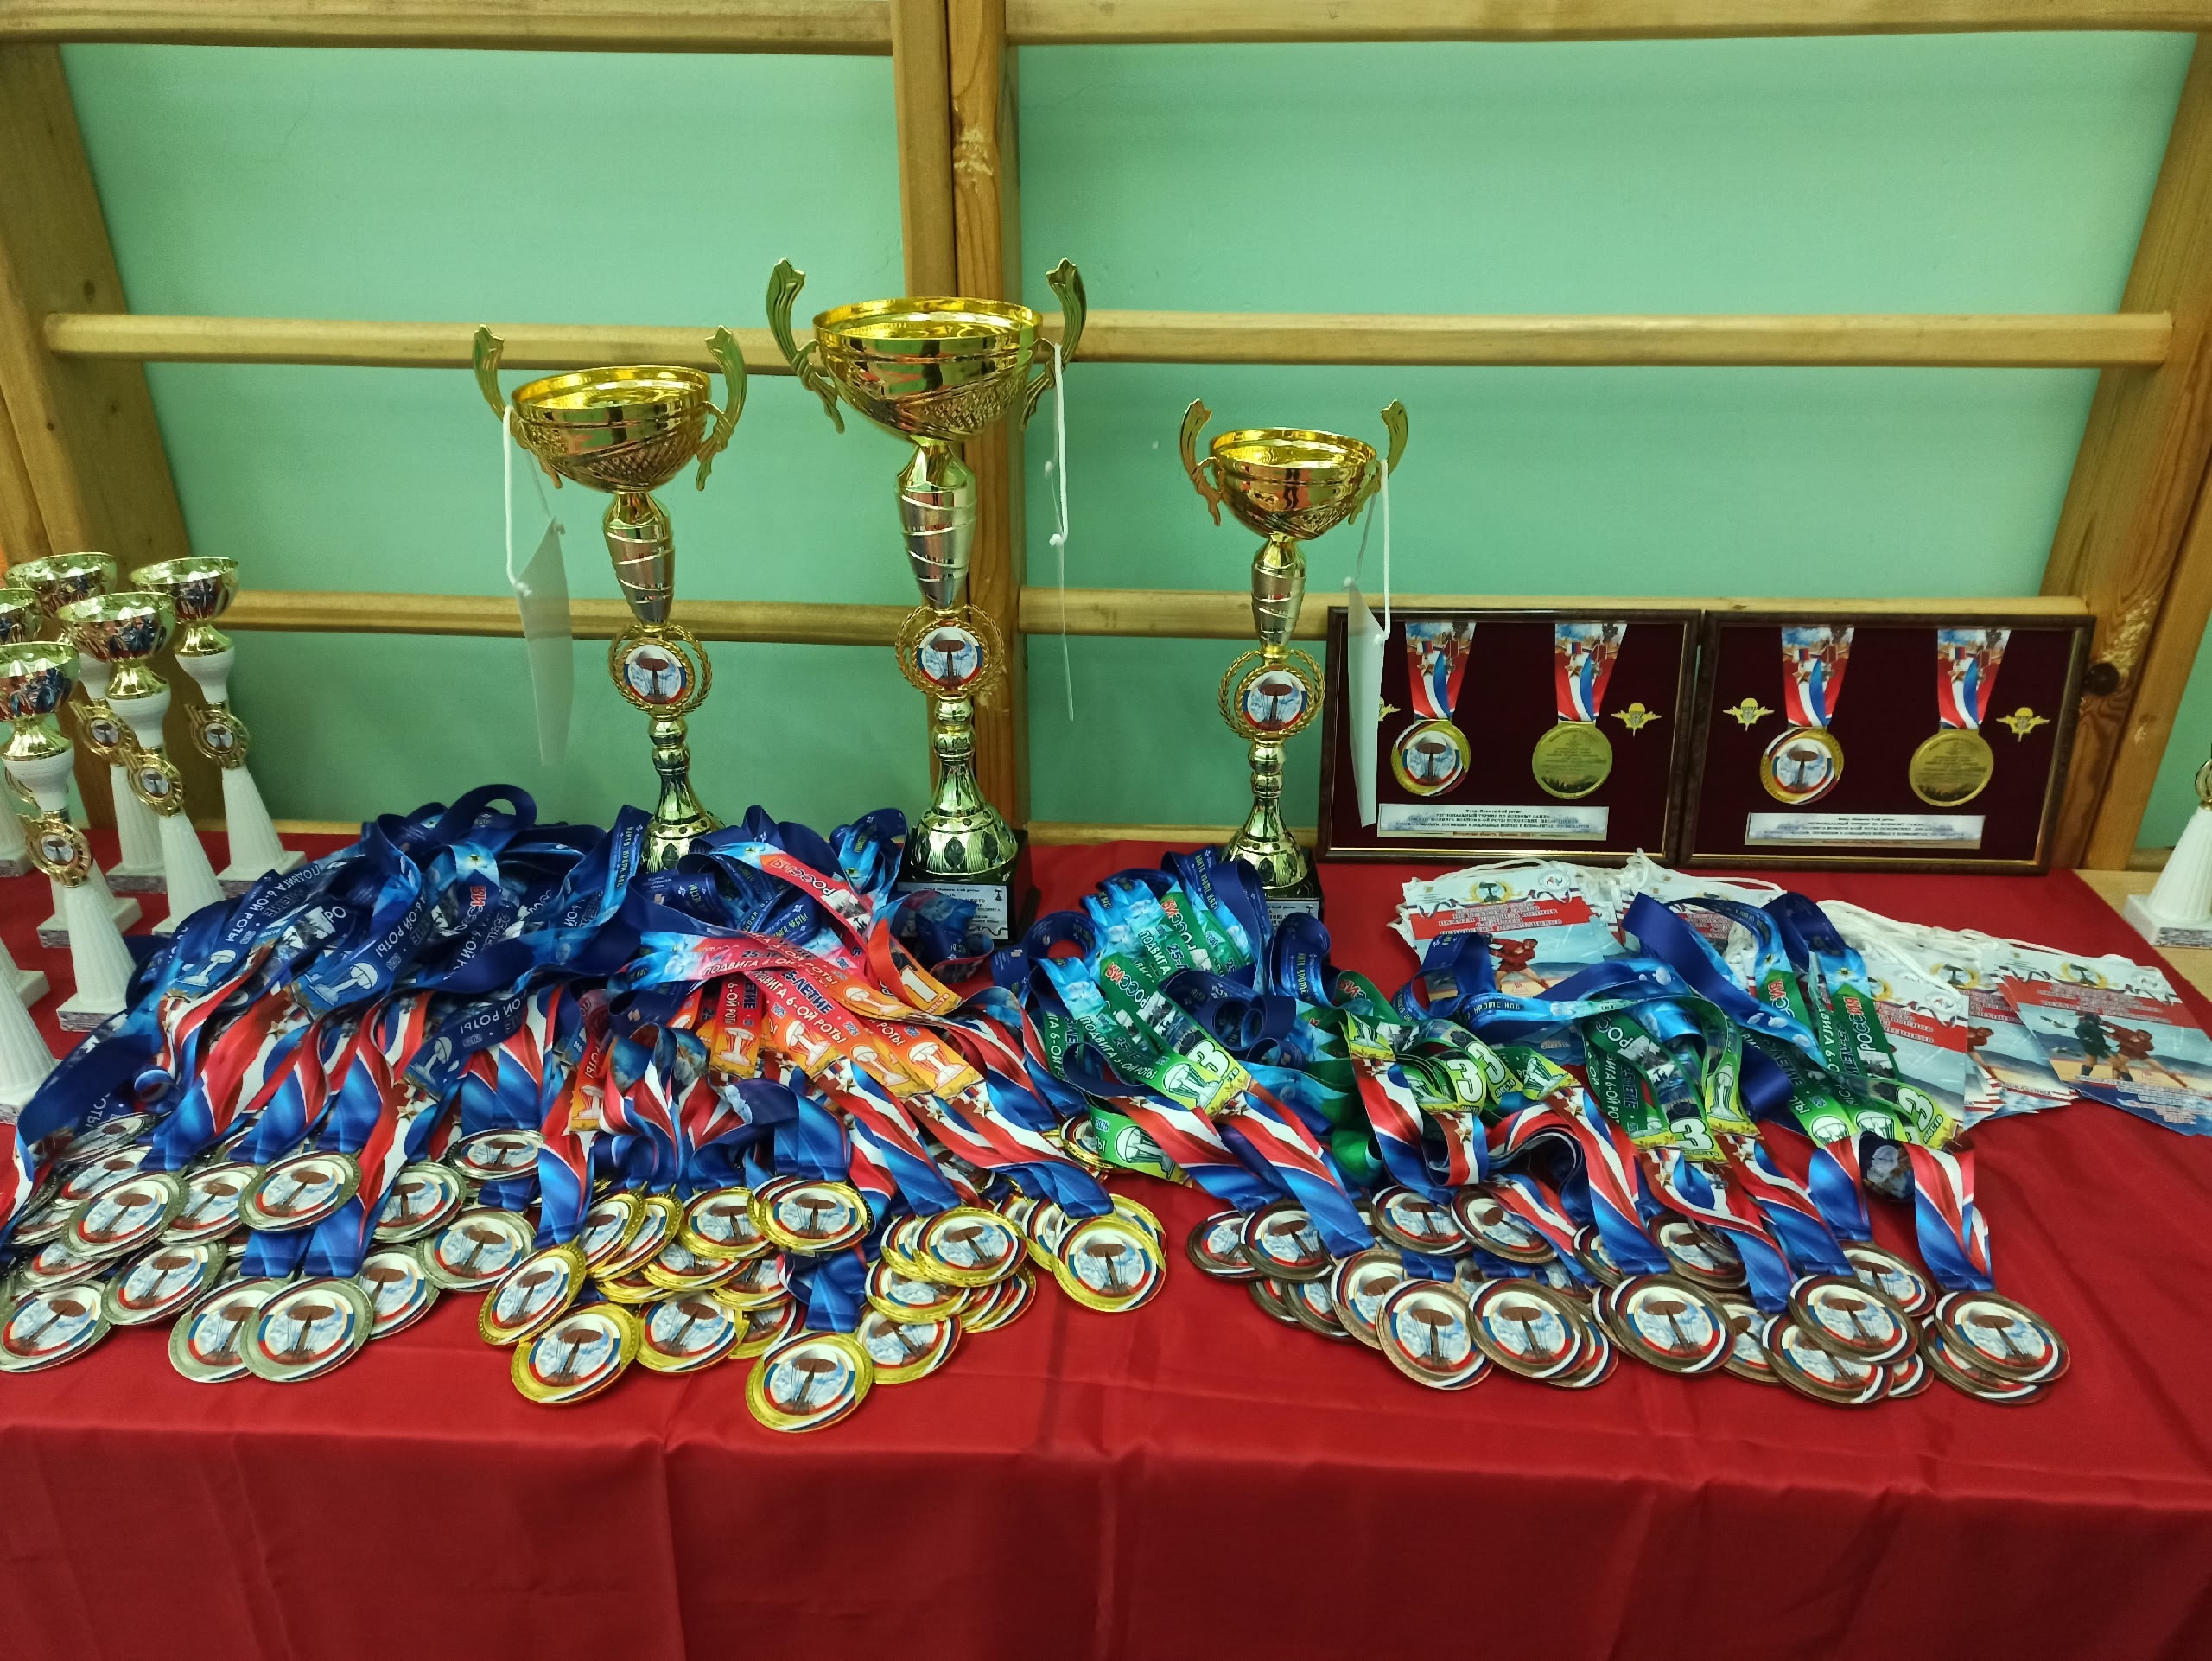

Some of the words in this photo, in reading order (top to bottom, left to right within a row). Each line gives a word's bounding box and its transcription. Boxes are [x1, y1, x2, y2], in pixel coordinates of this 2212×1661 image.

[226, 912, 254, 942] РОТЫ
[375, 926, 404, 958] РОТЫ
[702, 958, 758, 977] ПОДВИГА
[1139, 930, 1171, 975] ПОДВИГА
[781, 969, 836, 1015] 5-ЛЕТИЕ
[900, 965, 938, 1003] 1
[1105, 962, 1150, 1009] РОССИЯ
[460, 1013, 499, 1034] РОТЫ
[785, 996, 819, 1021] 6-ОЙ
[816, 1018, 848, 1044] РОТЫ
[877, 1022, 906, 1046] РОТЫ
[1080, 1015, 1117, 1060] ПОДВИГА
[1844, 996, 1876, 1052] РОССИЯ
[1186, 1039, 1230, 1079] 3
[1467, 1041, 1507, 1085] 3
[1445, 1058, 1483, 1104] 3
[1496, 1079, 1516, 1098] МЕСТО
[1897, 1087, 1934, 1132] 3
[1923, 1115, 1943, 1143] МЕСТО
[1669, 1117, 1714, 1150] 3
